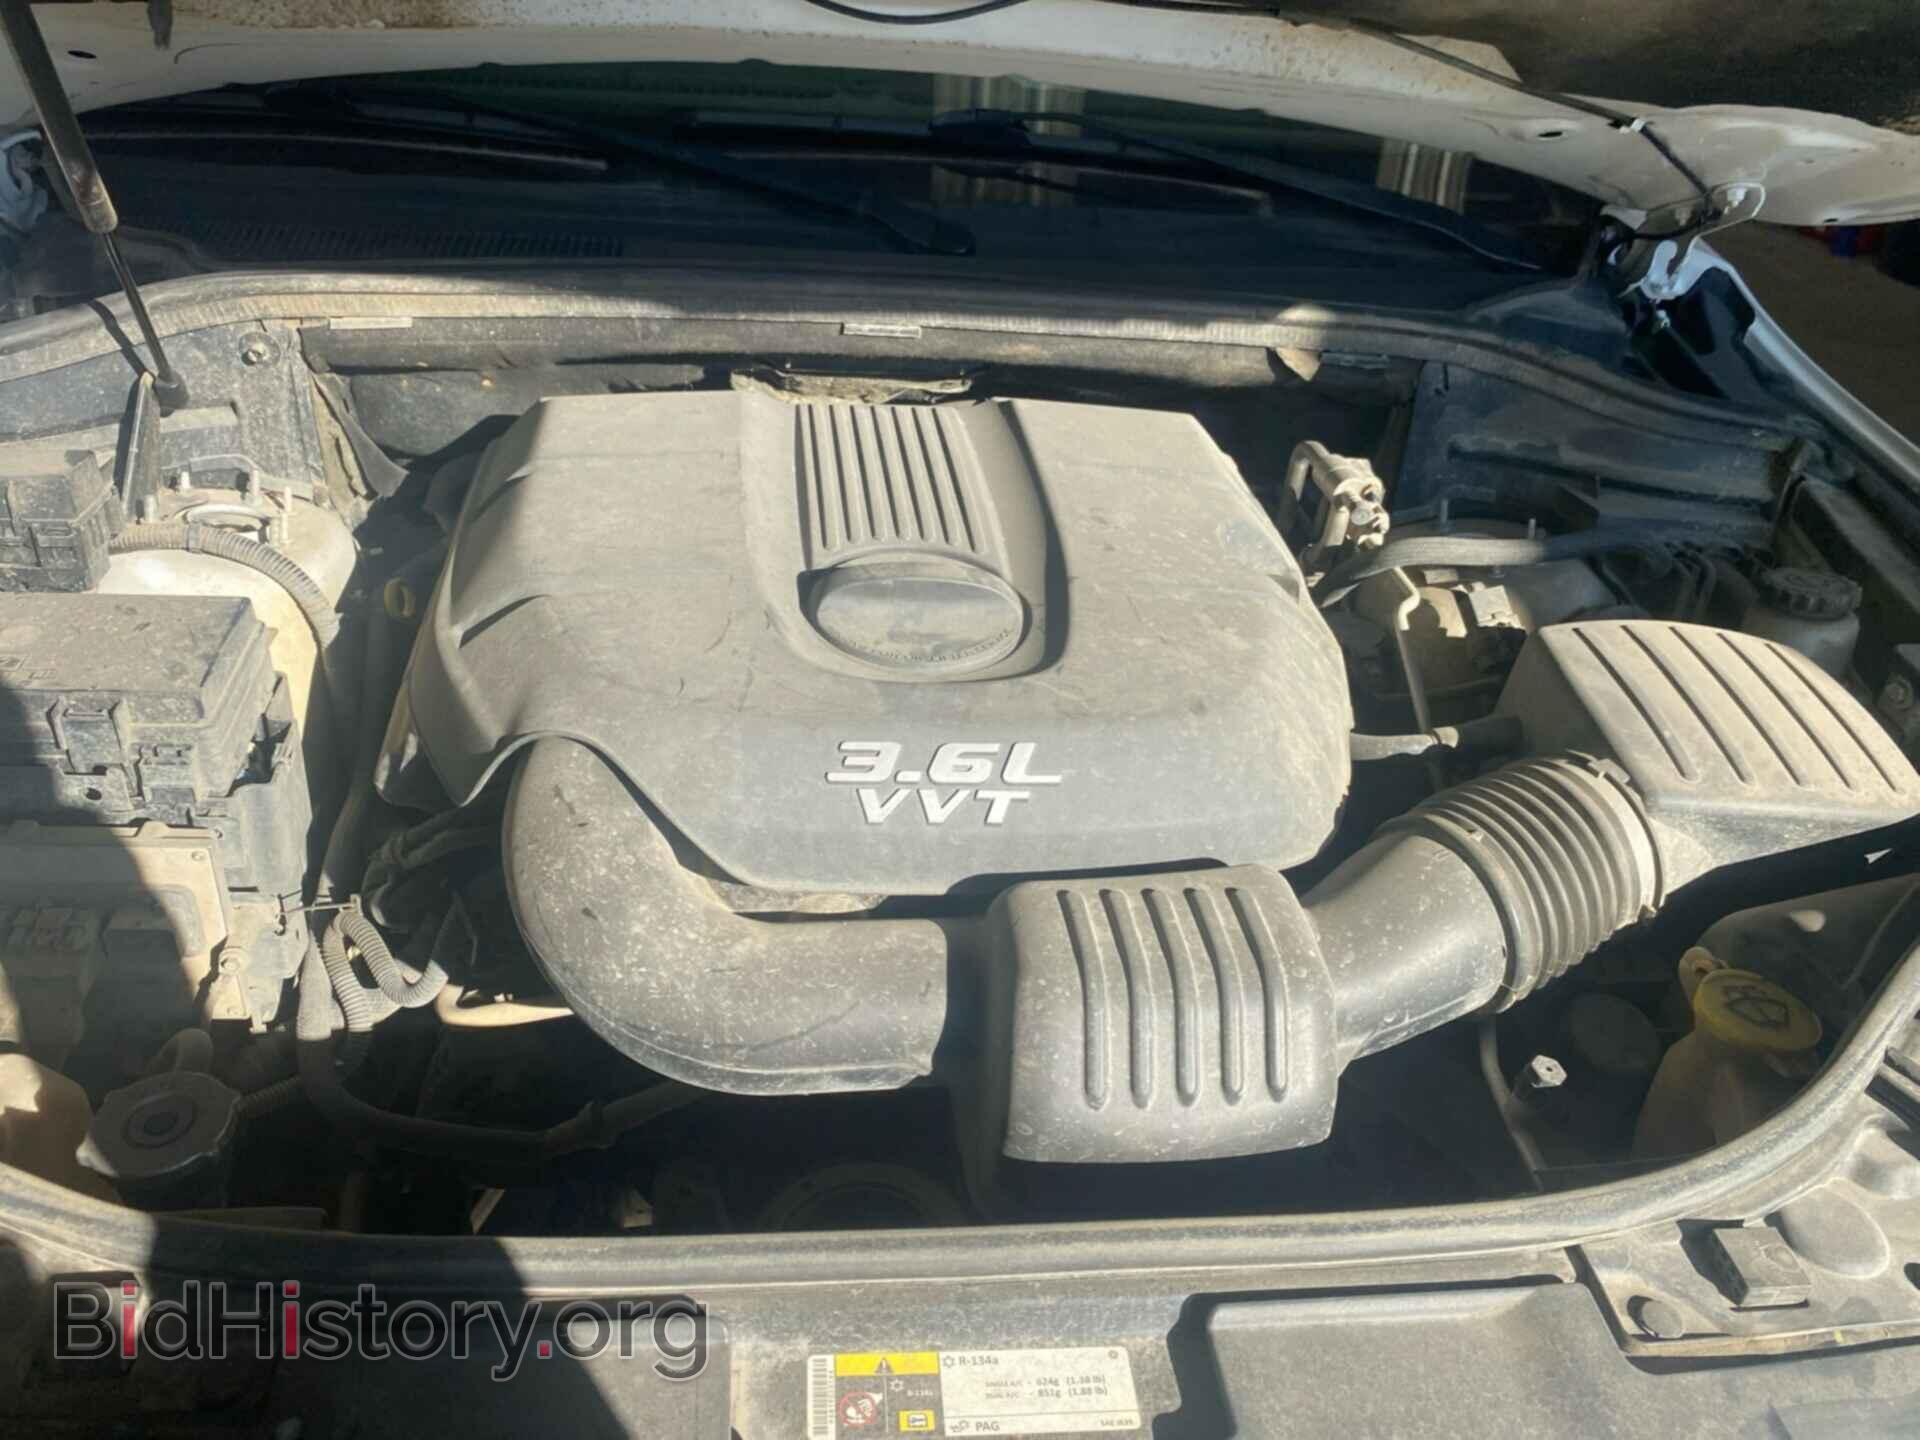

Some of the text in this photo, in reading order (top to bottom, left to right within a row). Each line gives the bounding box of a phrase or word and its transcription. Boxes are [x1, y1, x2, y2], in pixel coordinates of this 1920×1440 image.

[825, 741, 1063, 785] 3.6L
[856, 788, 1032, 825] VVT
[958, 1355, 999, 1366] R-134a
[975, 1421, 1000, 1431] PAG
